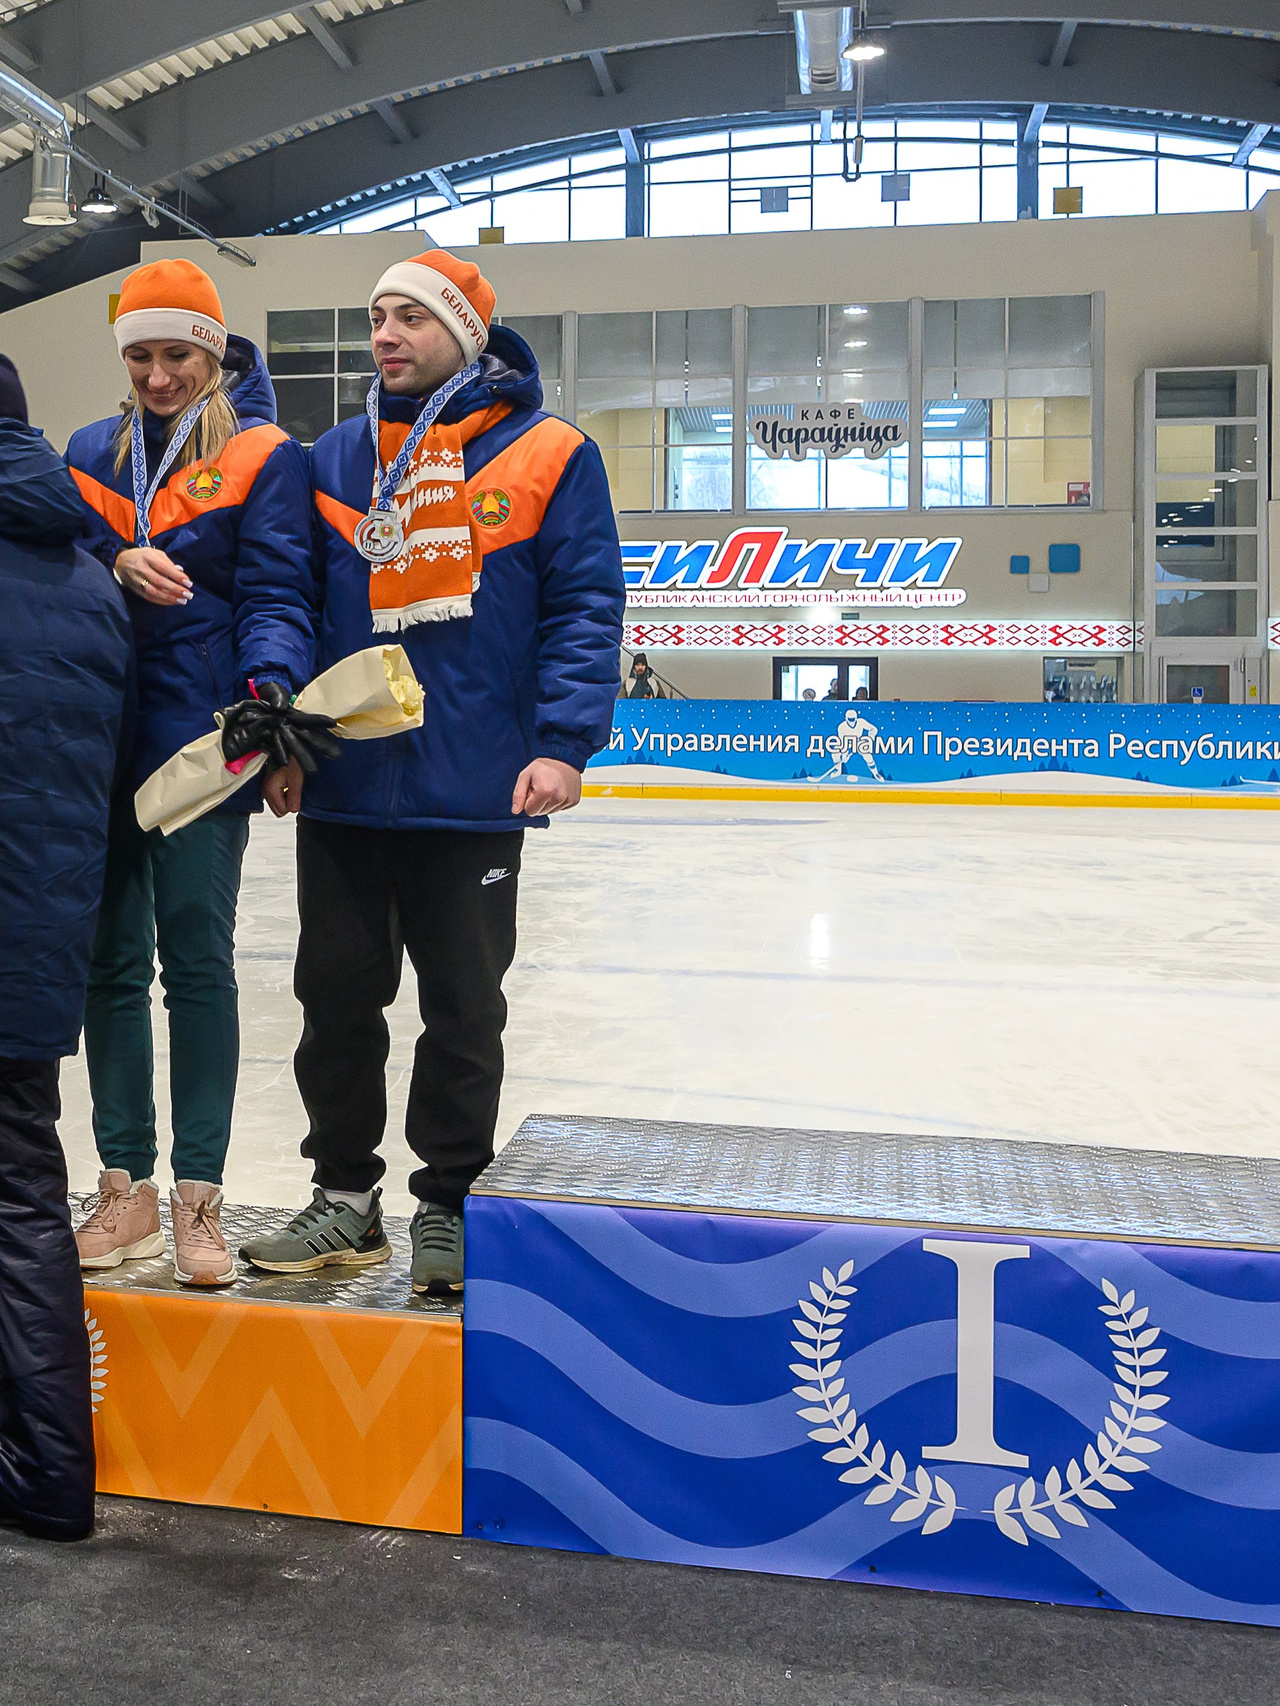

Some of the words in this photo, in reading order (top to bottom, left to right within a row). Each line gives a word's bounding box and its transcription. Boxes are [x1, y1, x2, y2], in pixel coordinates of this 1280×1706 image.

[801, 408, 856, 421] КАФЕ
[764, 590, 902, 603] ГОРНОЛЫЖНЫЙ
[906, 593, 962, 605] ЦЕНТР
[631, 726, 799, 756] Управления
[806, 733, 914, 757] делами
[922, 730, 1100, 761] Президента
